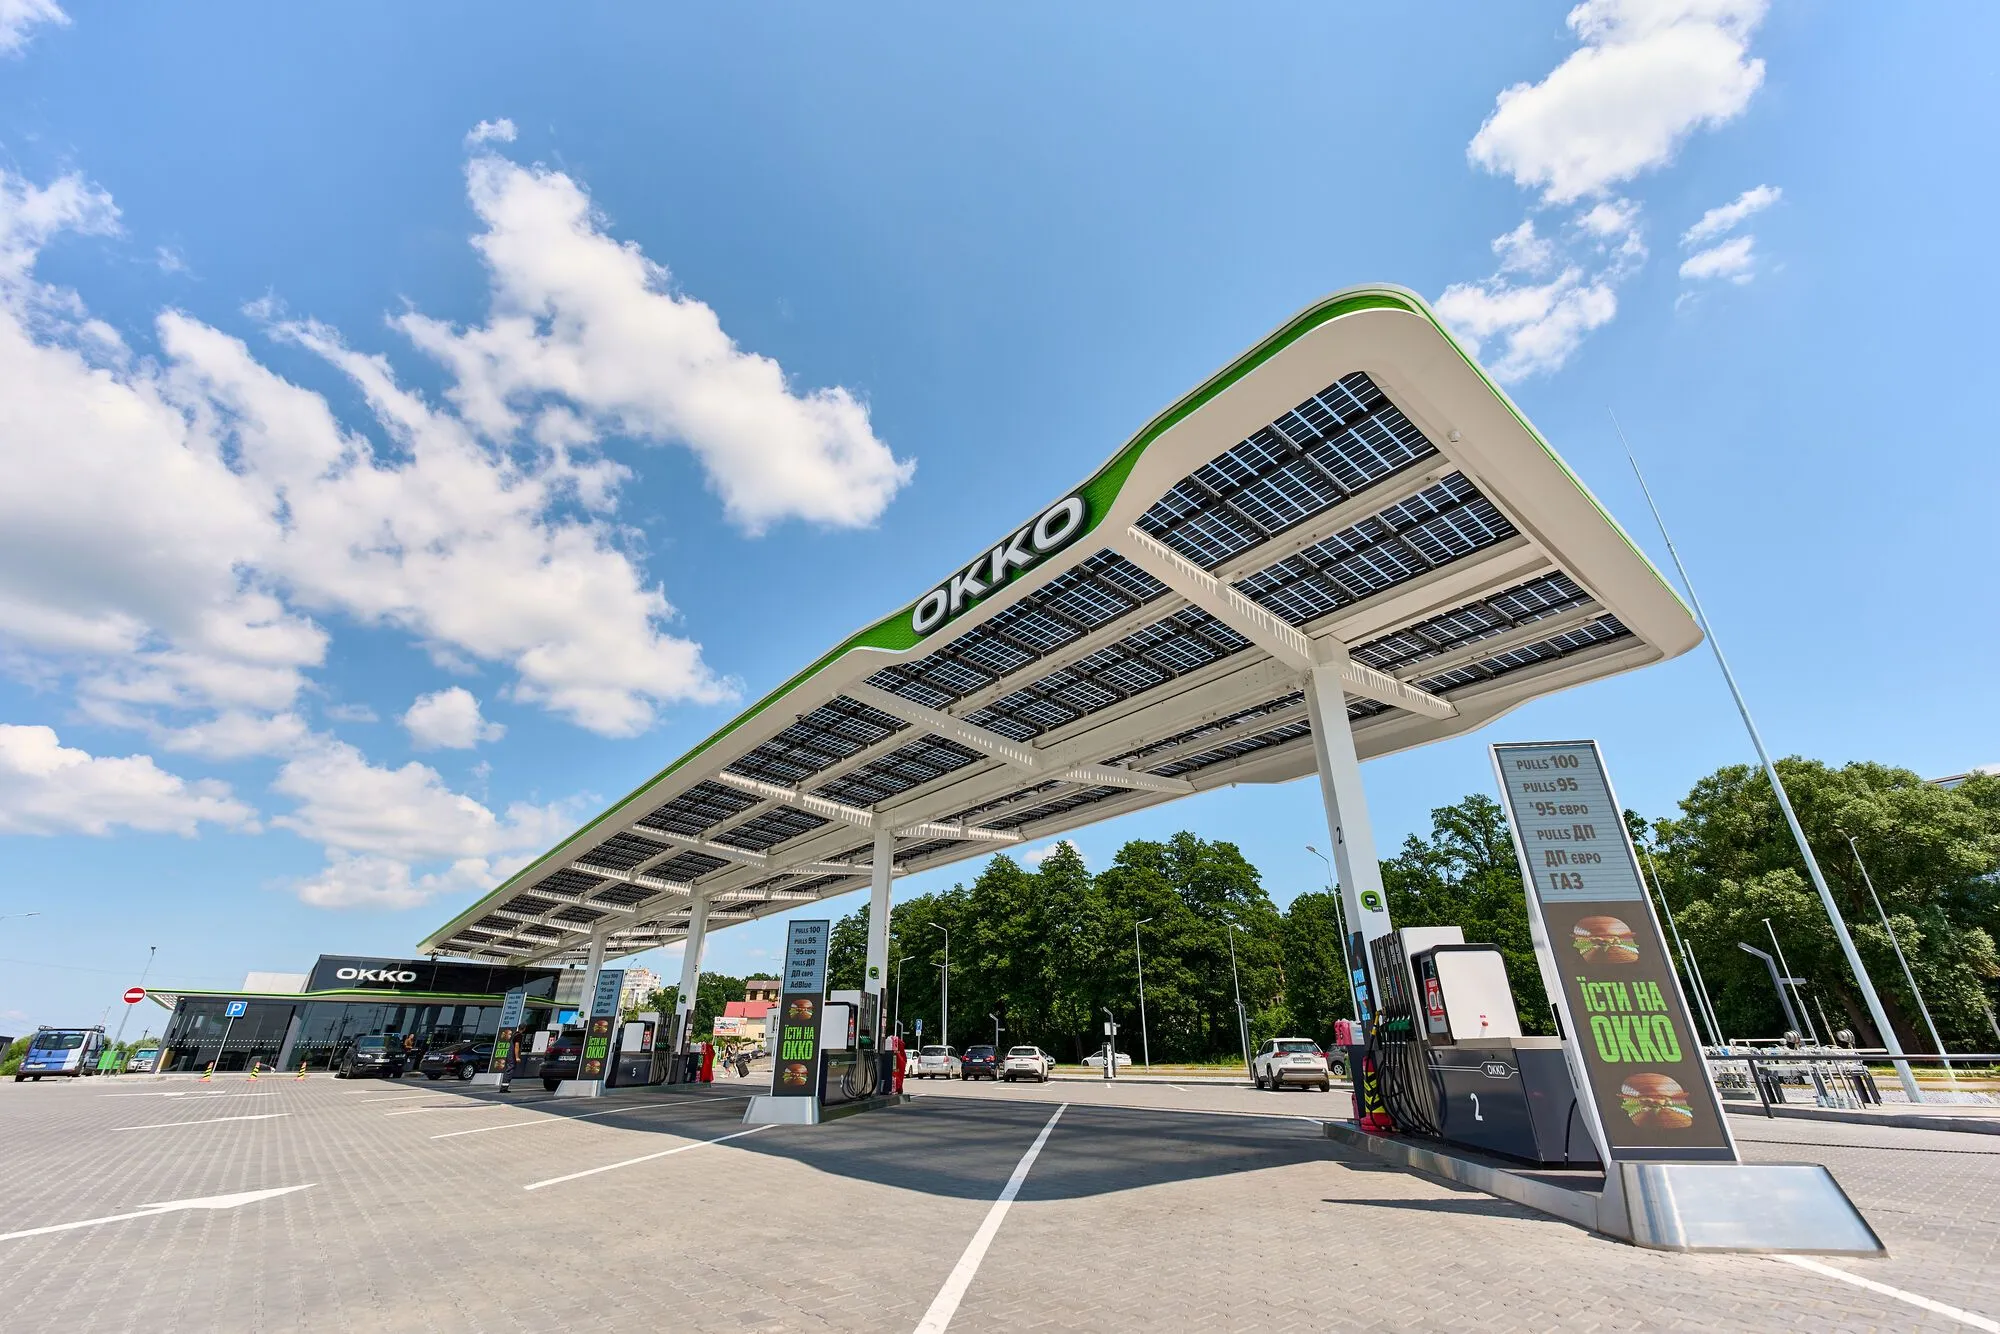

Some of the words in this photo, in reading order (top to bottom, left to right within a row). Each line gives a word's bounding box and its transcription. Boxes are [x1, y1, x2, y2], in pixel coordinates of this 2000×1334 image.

[911, 495, 1084, 635] OKKO
[1516, 759, 1550, 770] PULLS
[1550, 754, 1579, 769] 100
[1522, 782, 1557, 793] PULLS
[1556, 777, 1578, 792] 95
[1559, 804, 1589, 815] ЄВРО
[1336, 826, 1343, 844] 2
[1536, 829, 1571, 840] PULLS
[1572, 824, 1596, 841] ДП
[1544, 850, 1568, 867] ДП
[1571, 853, 1602, 864] ЄВРО
[1549, 872, 1585, 890] ГАЗ
[809, 926, 821, 934] 100
[336, 967, 417, 983] OKKO
[1576, 976, 1633, 1013] ЇСТИ
[1632, 981, 1668, 1012] НА
[230, 1003, 242, 1015] P
[784, 1024, 802, 1040] ЇСТИ
[803, 1026, 814, 1040] НА
[1590, 1014, 1683, 1063] ОККО
[782, 1040, 814, 1060] ОККО
[1487, 1064, 1505, 1076] OKKO
[1470, 1092, 1484, 1121] 2
